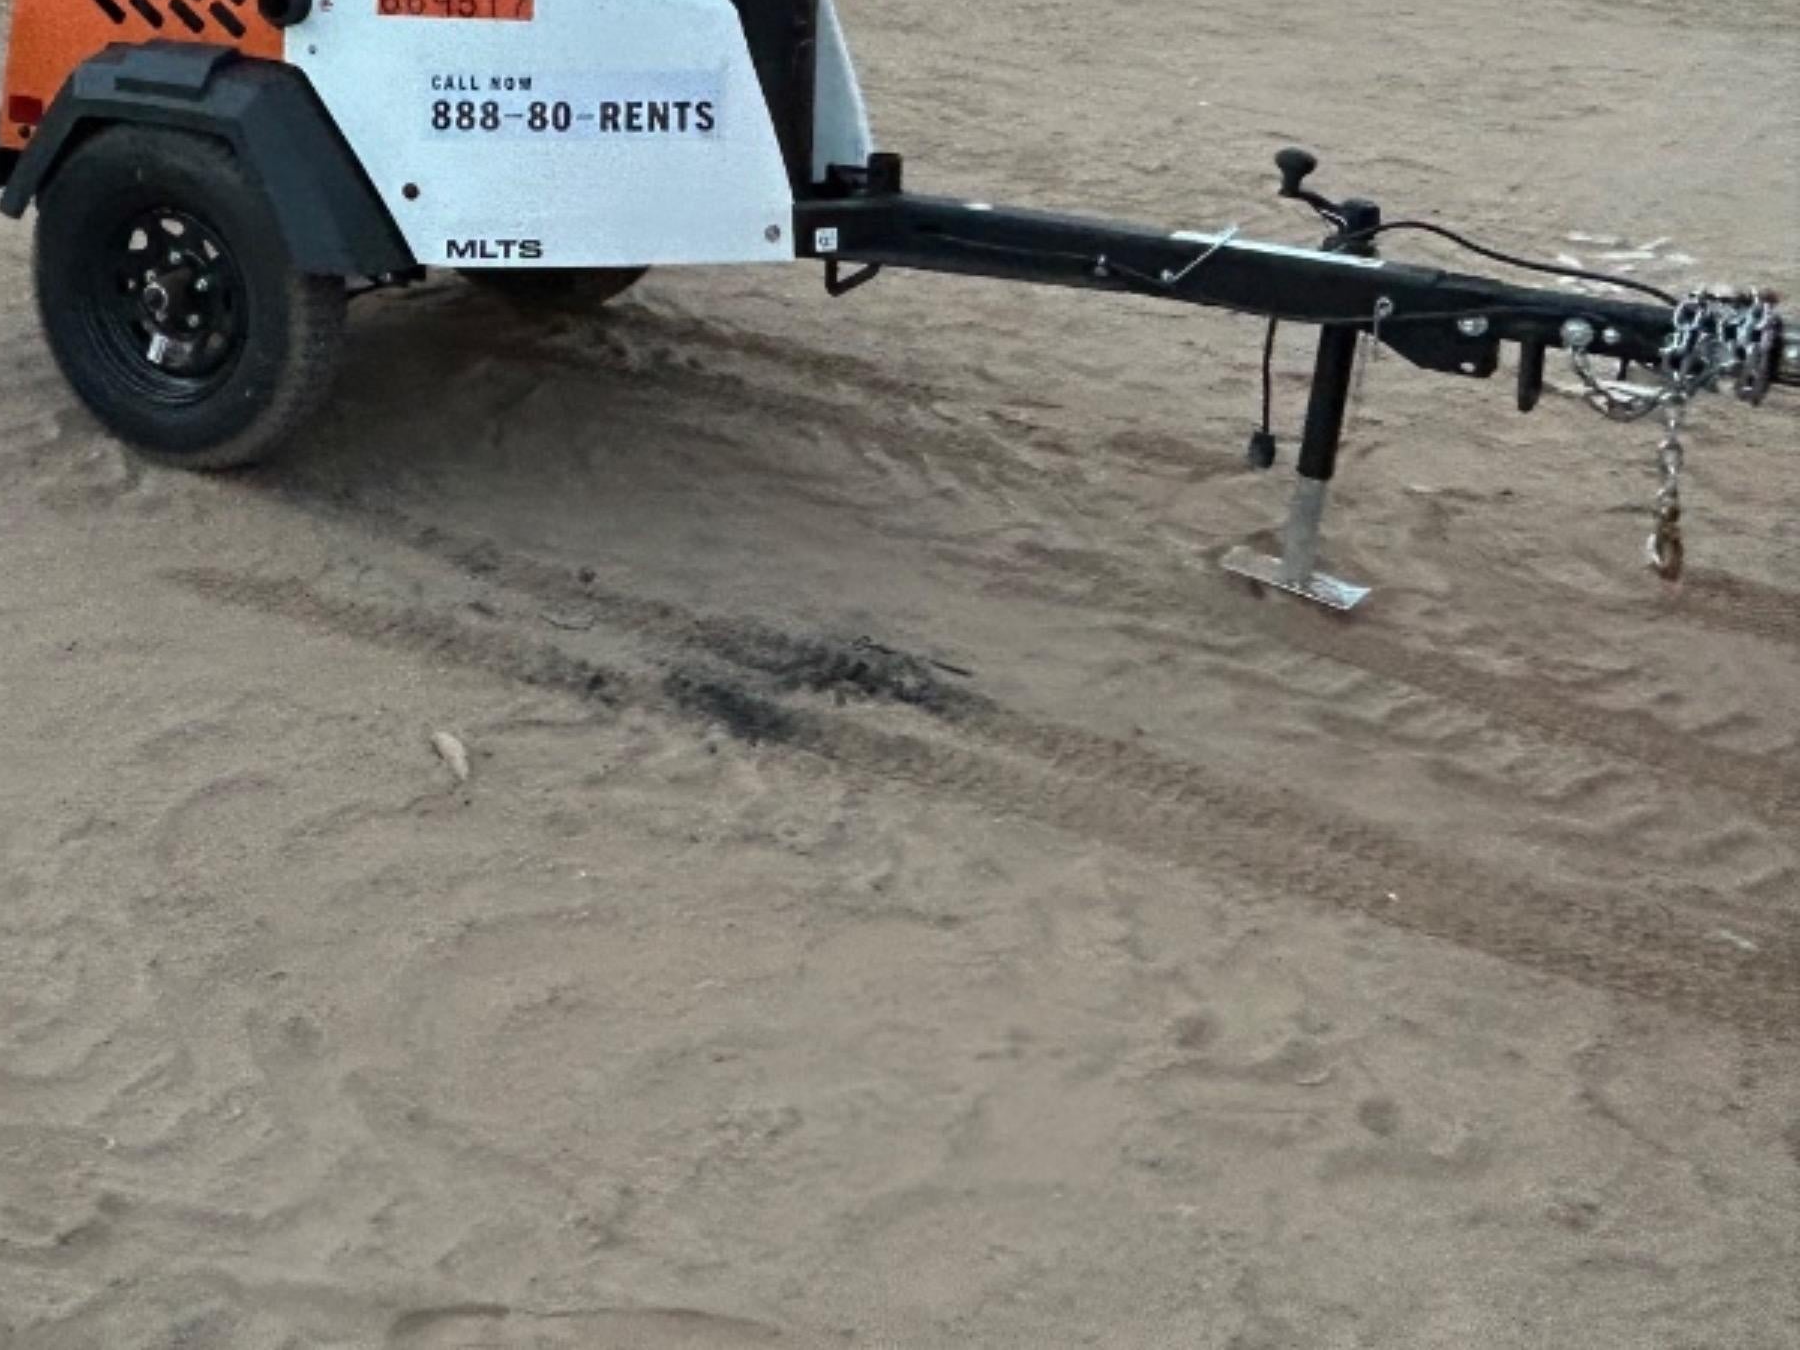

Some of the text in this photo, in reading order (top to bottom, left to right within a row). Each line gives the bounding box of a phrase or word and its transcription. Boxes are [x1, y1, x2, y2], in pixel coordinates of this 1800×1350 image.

[431, 75, 532, 90] CALL NOW
[431, 100, 715, 132] 888-80-RENTS
[446, 239, 543, 258] MLTS
